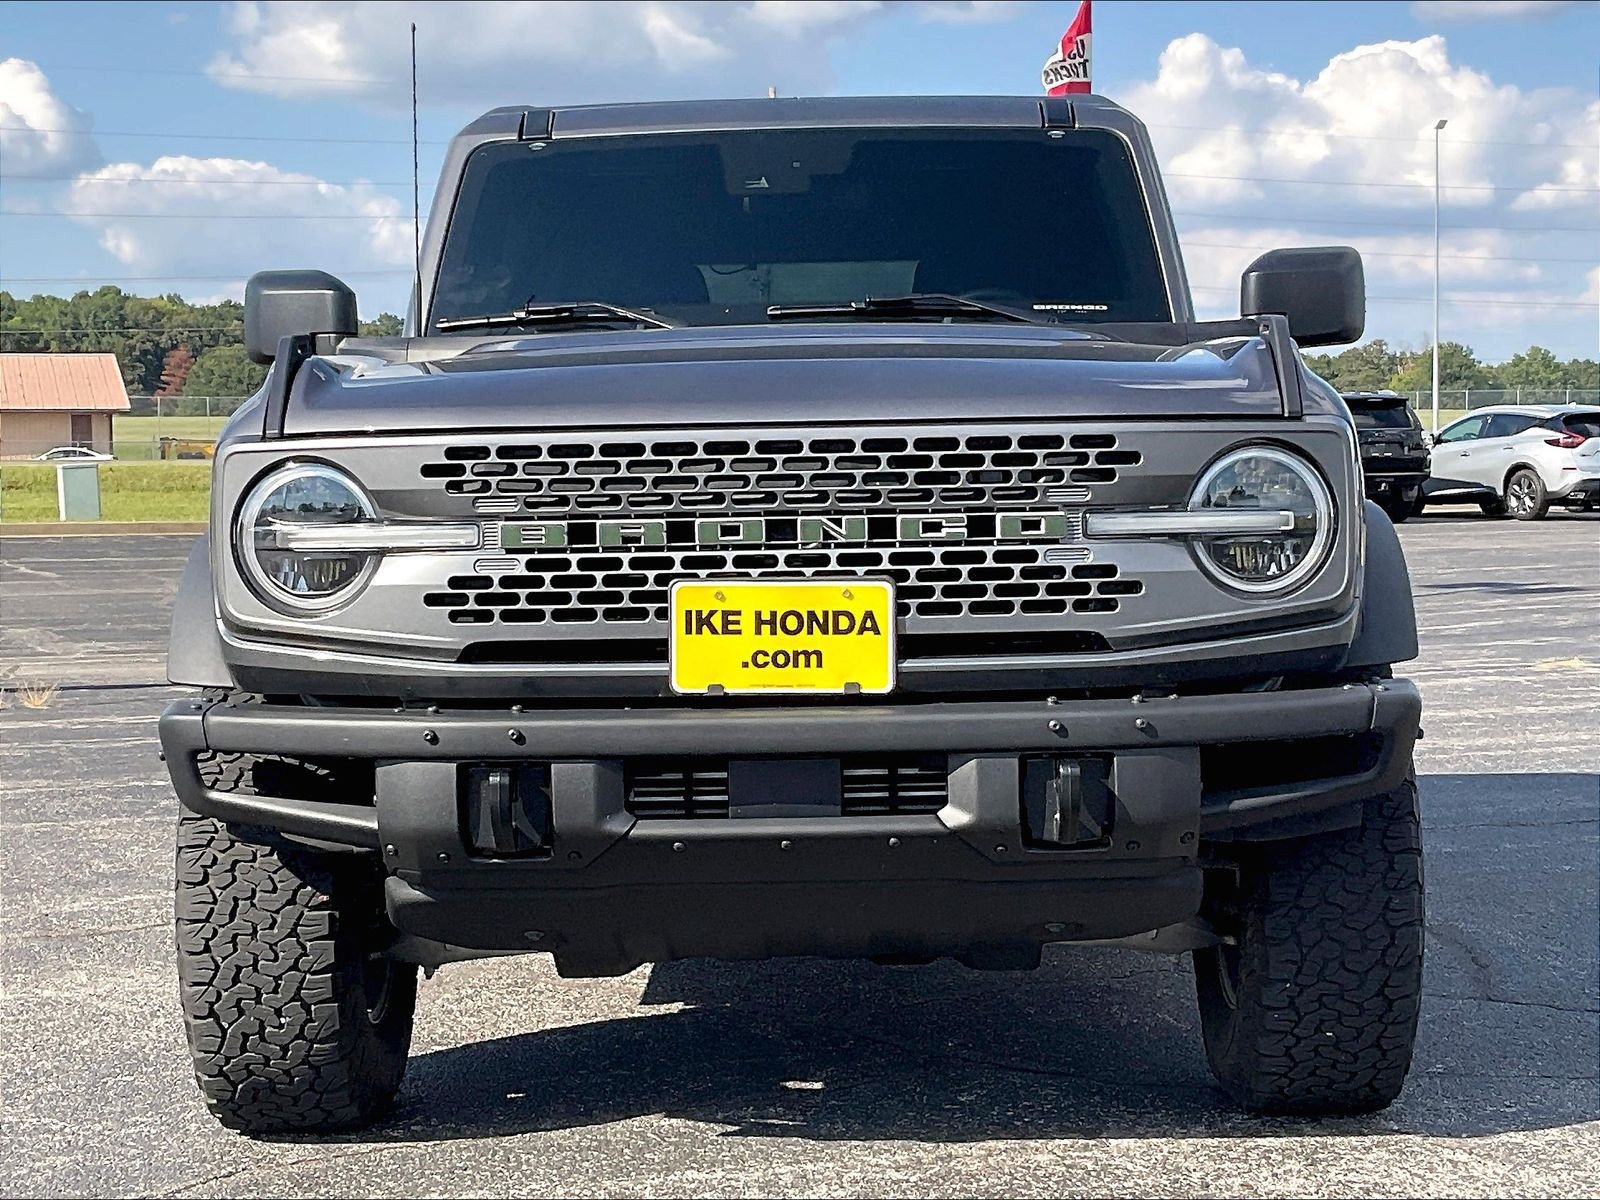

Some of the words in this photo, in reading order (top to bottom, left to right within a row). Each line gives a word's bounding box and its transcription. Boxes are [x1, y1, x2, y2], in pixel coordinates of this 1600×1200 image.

[499, 511, 1069, 548] BRONCO
[685, 609, 742, 635] IKE
[754, 609, 881, 636] HONDA
[742, 649, 823, 668] .com
